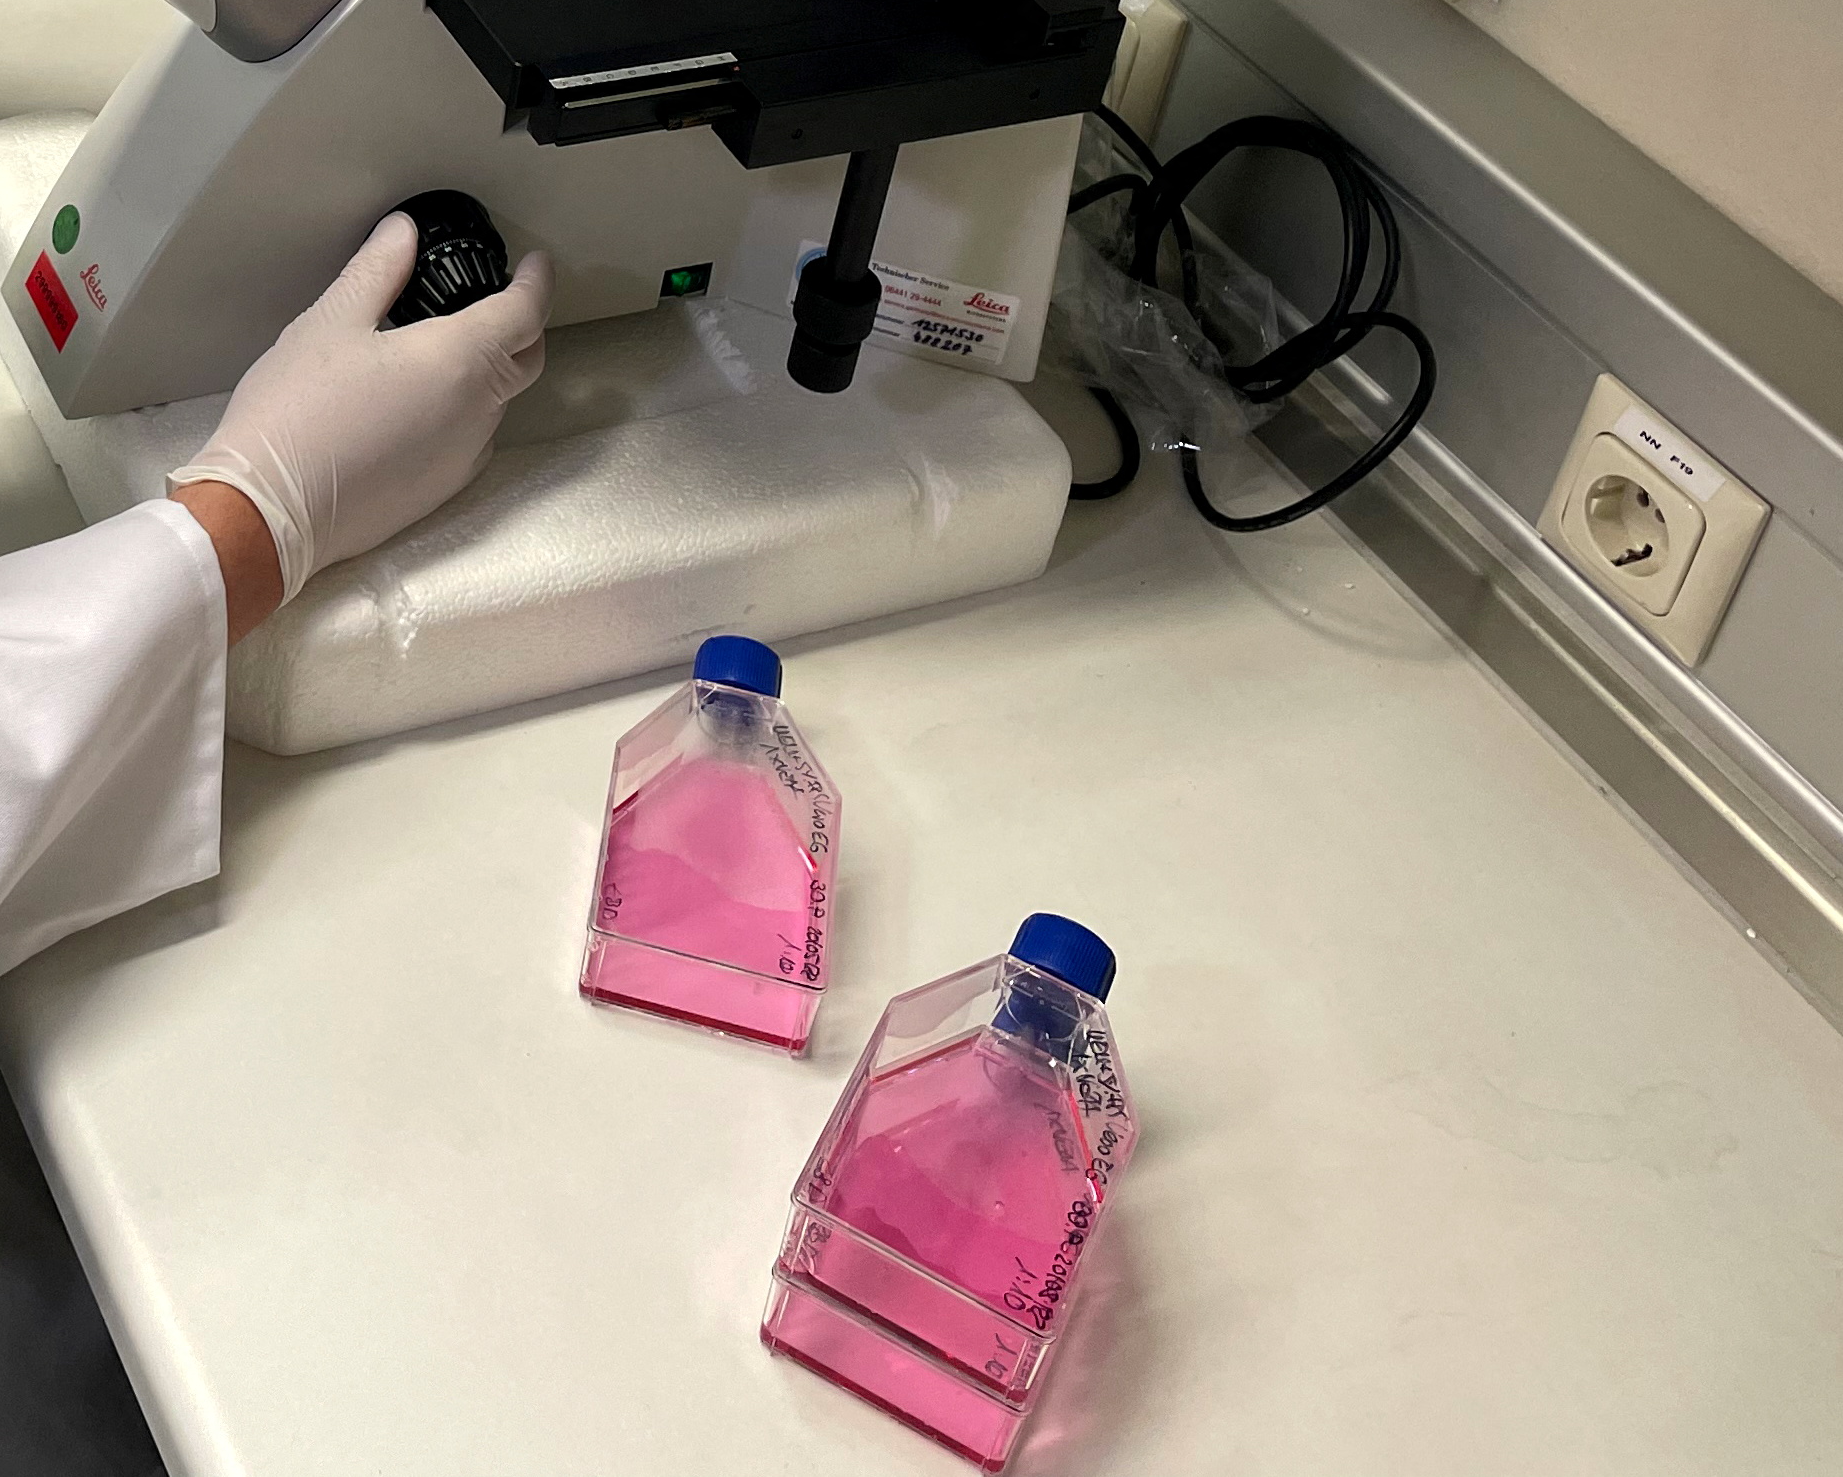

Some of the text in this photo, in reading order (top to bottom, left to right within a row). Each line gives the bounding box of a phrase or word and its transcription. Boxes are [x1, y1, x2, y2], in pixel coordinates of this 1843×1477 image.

[79, 263, 108, 313] Leica
[963, 291, 1010, 316] Leica
[1639, 430, 1662, 450] NN
